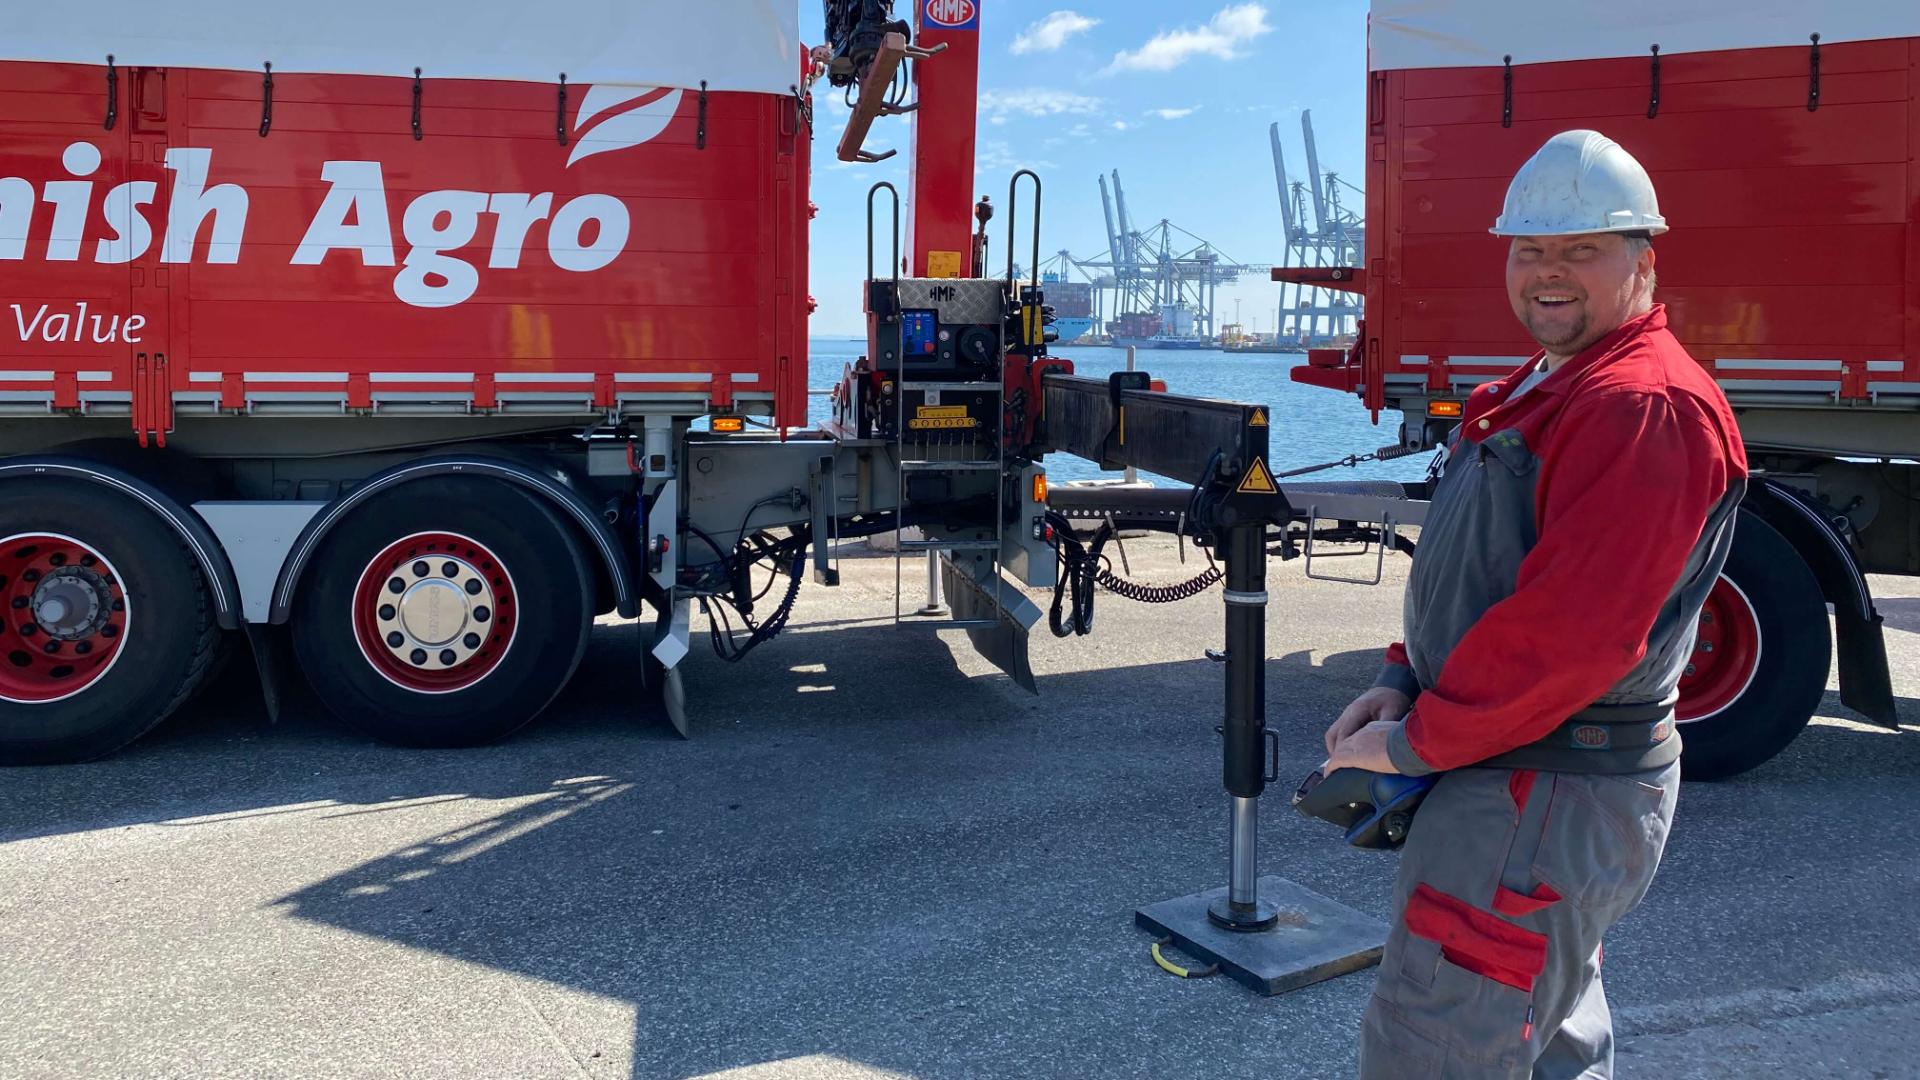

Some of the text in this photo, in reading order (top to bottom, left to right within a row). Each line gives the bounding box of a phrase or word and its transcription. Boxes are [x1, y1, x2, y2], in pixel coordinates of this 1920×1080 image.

[933, 0, 969, 22] HMF
[289, 160, 630, 308] Agro
[930, 285, 956, 302] HMF
[10, 302, 146, 343] Value
